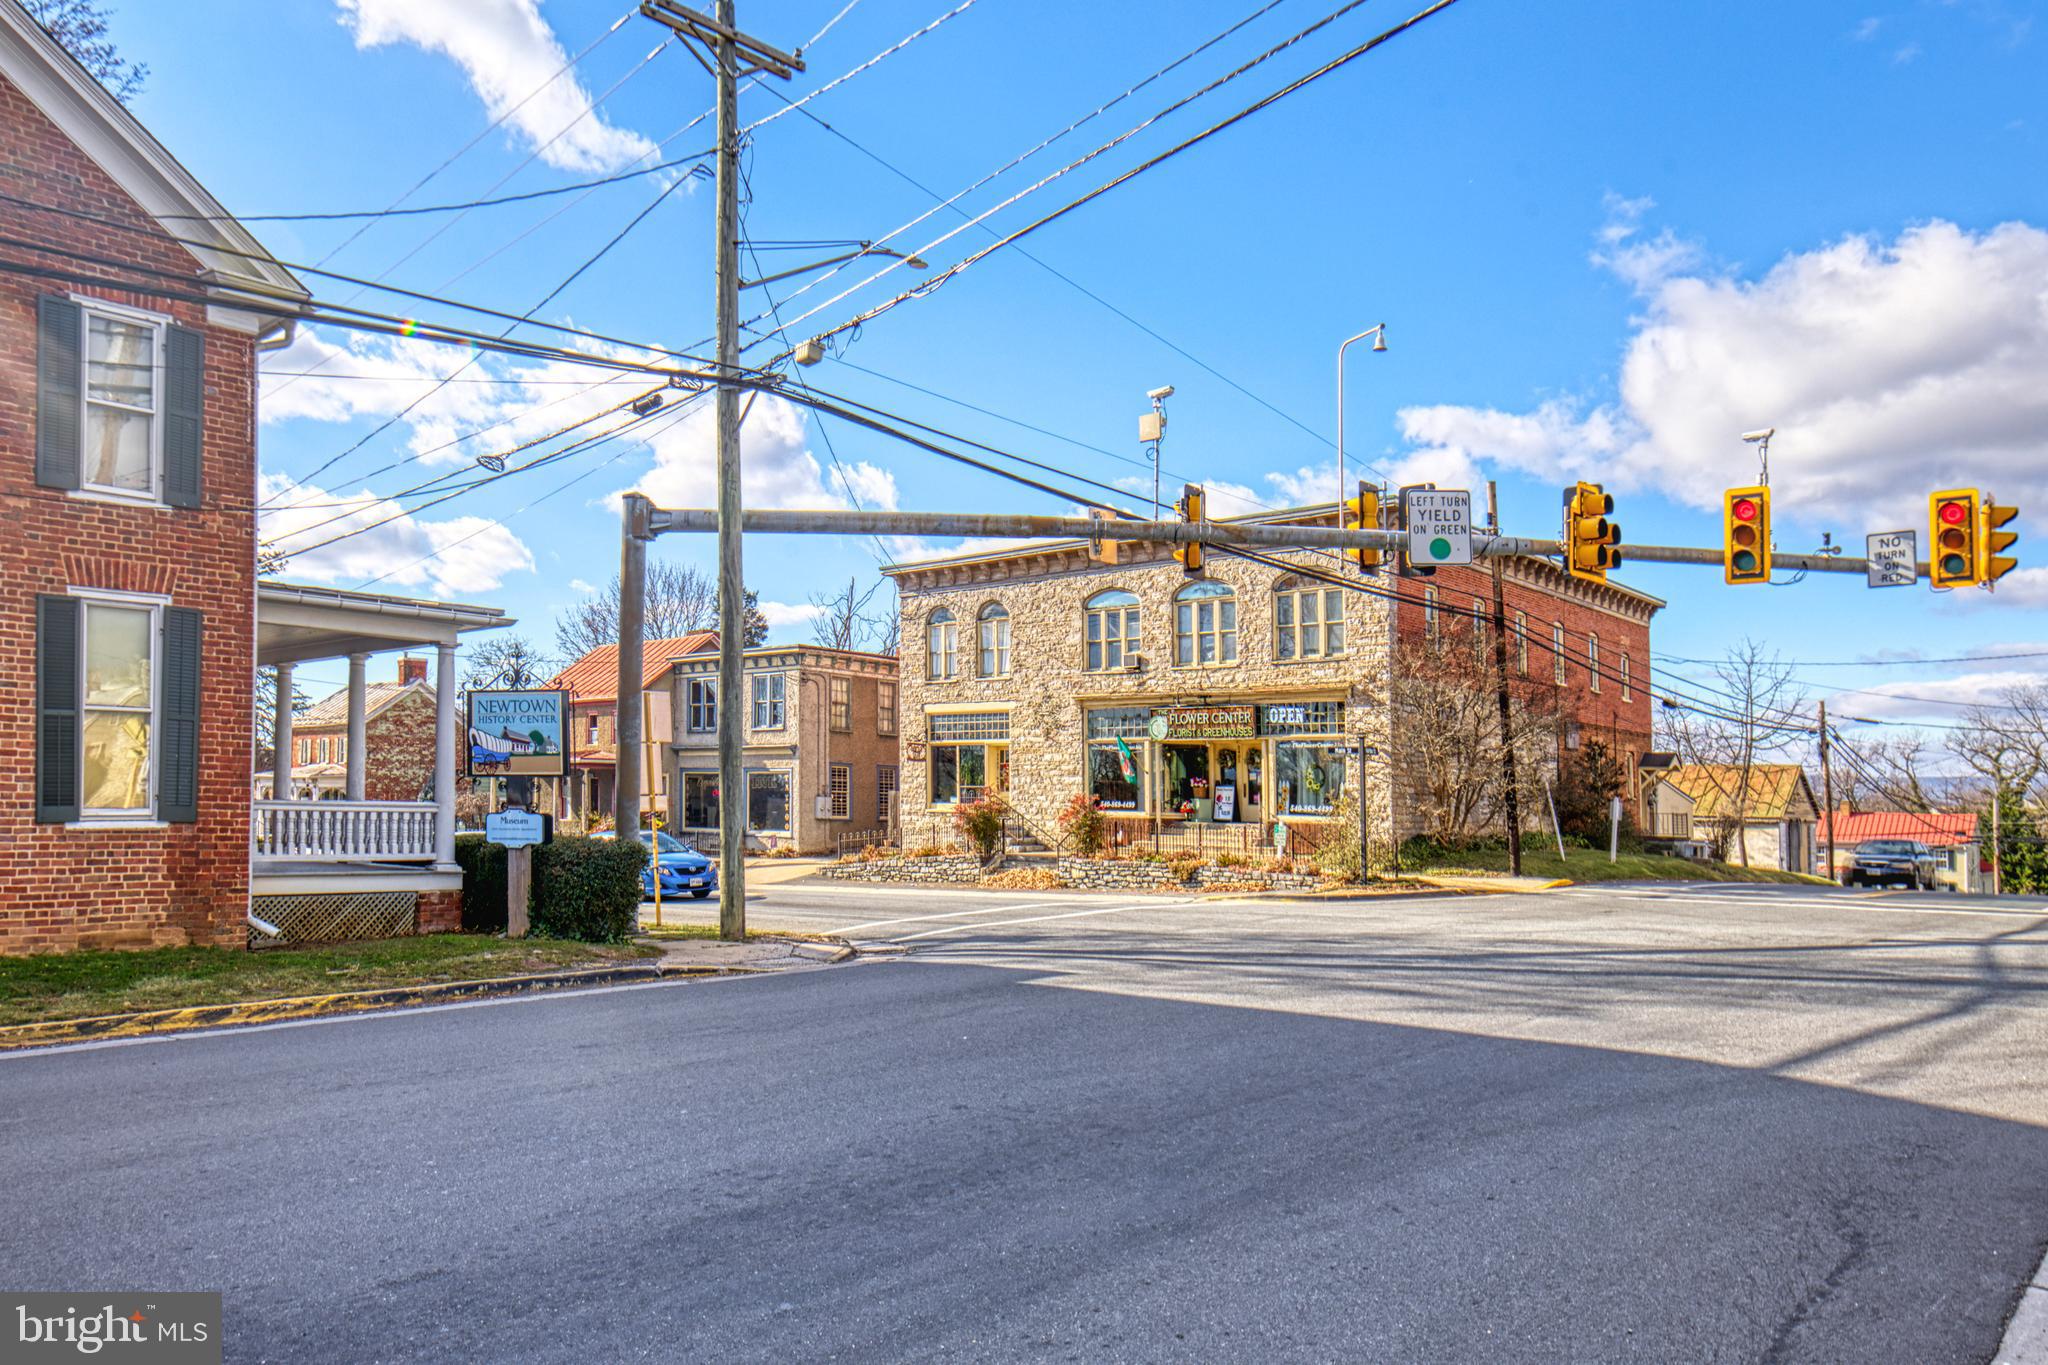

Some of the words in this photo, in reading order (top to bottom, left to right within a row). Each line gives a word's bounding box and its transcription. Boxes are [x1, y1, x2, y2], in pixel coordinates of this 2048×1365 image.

[1411, 496, 1434, 507] LEFT
[1441, 496, 1468, 507] TURN
[1418, 509, 1461, 522] YIELD
[1413, 525, 1427, 535] ON
[1434, 525, 1467, 535] GREEN
[1879, 536, 1901, 549] NO
[1876, 549, 1906, 560] TURN
[1884, 561, 1899, 571] ON
[1881, 573, 1902, 583] RED
[477, 699, 556, 714] NEWTOWN
[478, 715, 516, 724] HISTORY
[520, 715, 557, 724] CENTER
[1169, 713, 1209, 725] FLOWER
[1211, 711, 1251, 724] CENTER
[1269, 708, 1304, 723] OPEN
[1168, 728, 1195, 737] FLORIST
[1202, 726, 1253, 737] GREENHOUSES
[500, 816, 529, 825] Museum
